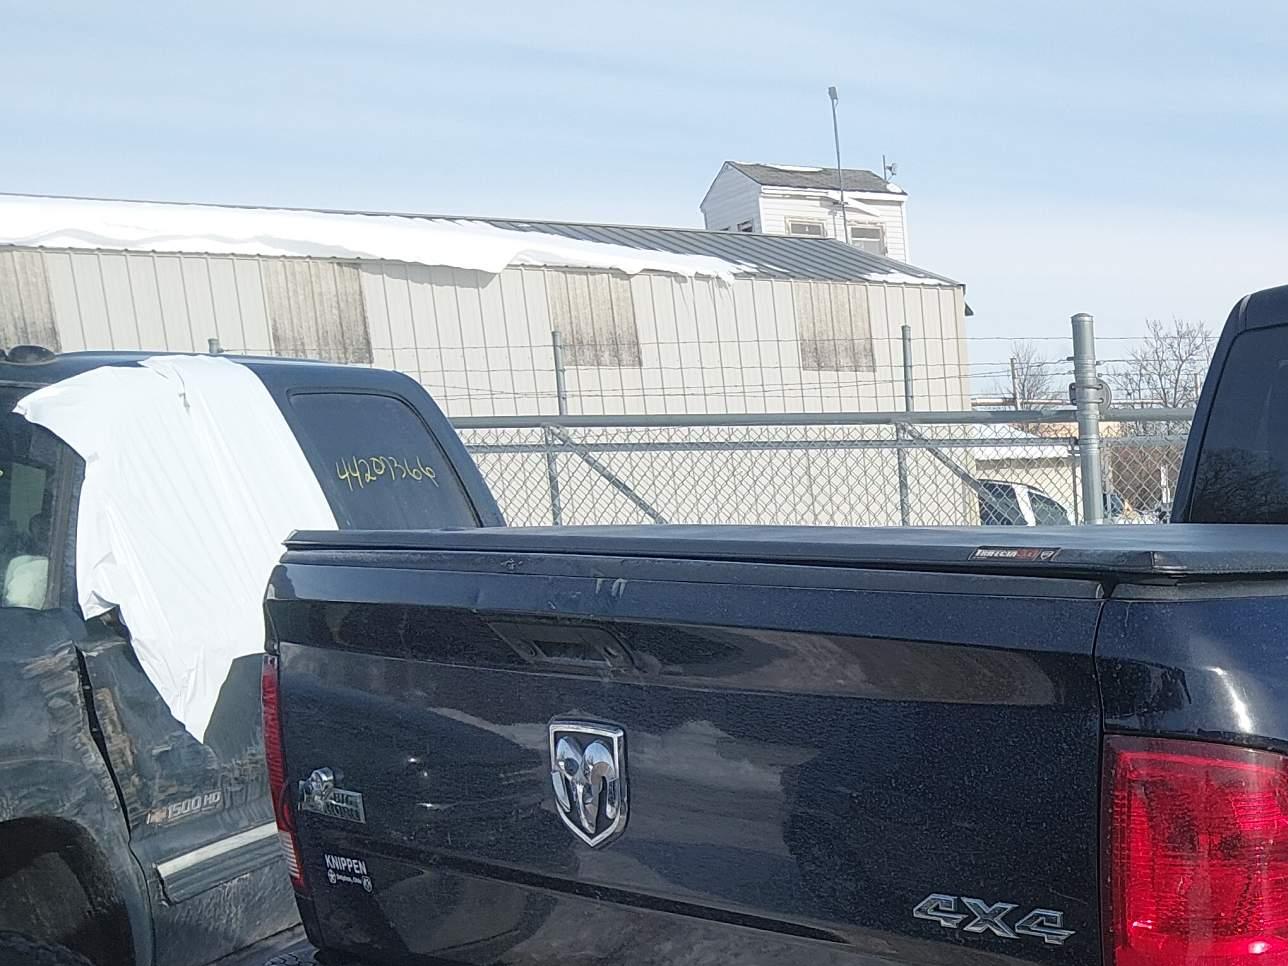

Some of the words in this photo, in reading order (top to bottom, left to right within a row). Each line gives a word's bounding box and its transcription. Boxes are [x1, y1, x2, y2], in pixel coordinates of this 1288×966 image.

[167, 795, 201, 819] 1500
[203, 791, 222, 806] HD
[333, 792, 354, 806] BIG
[324, 853, 368, 876] KNIPPEN
